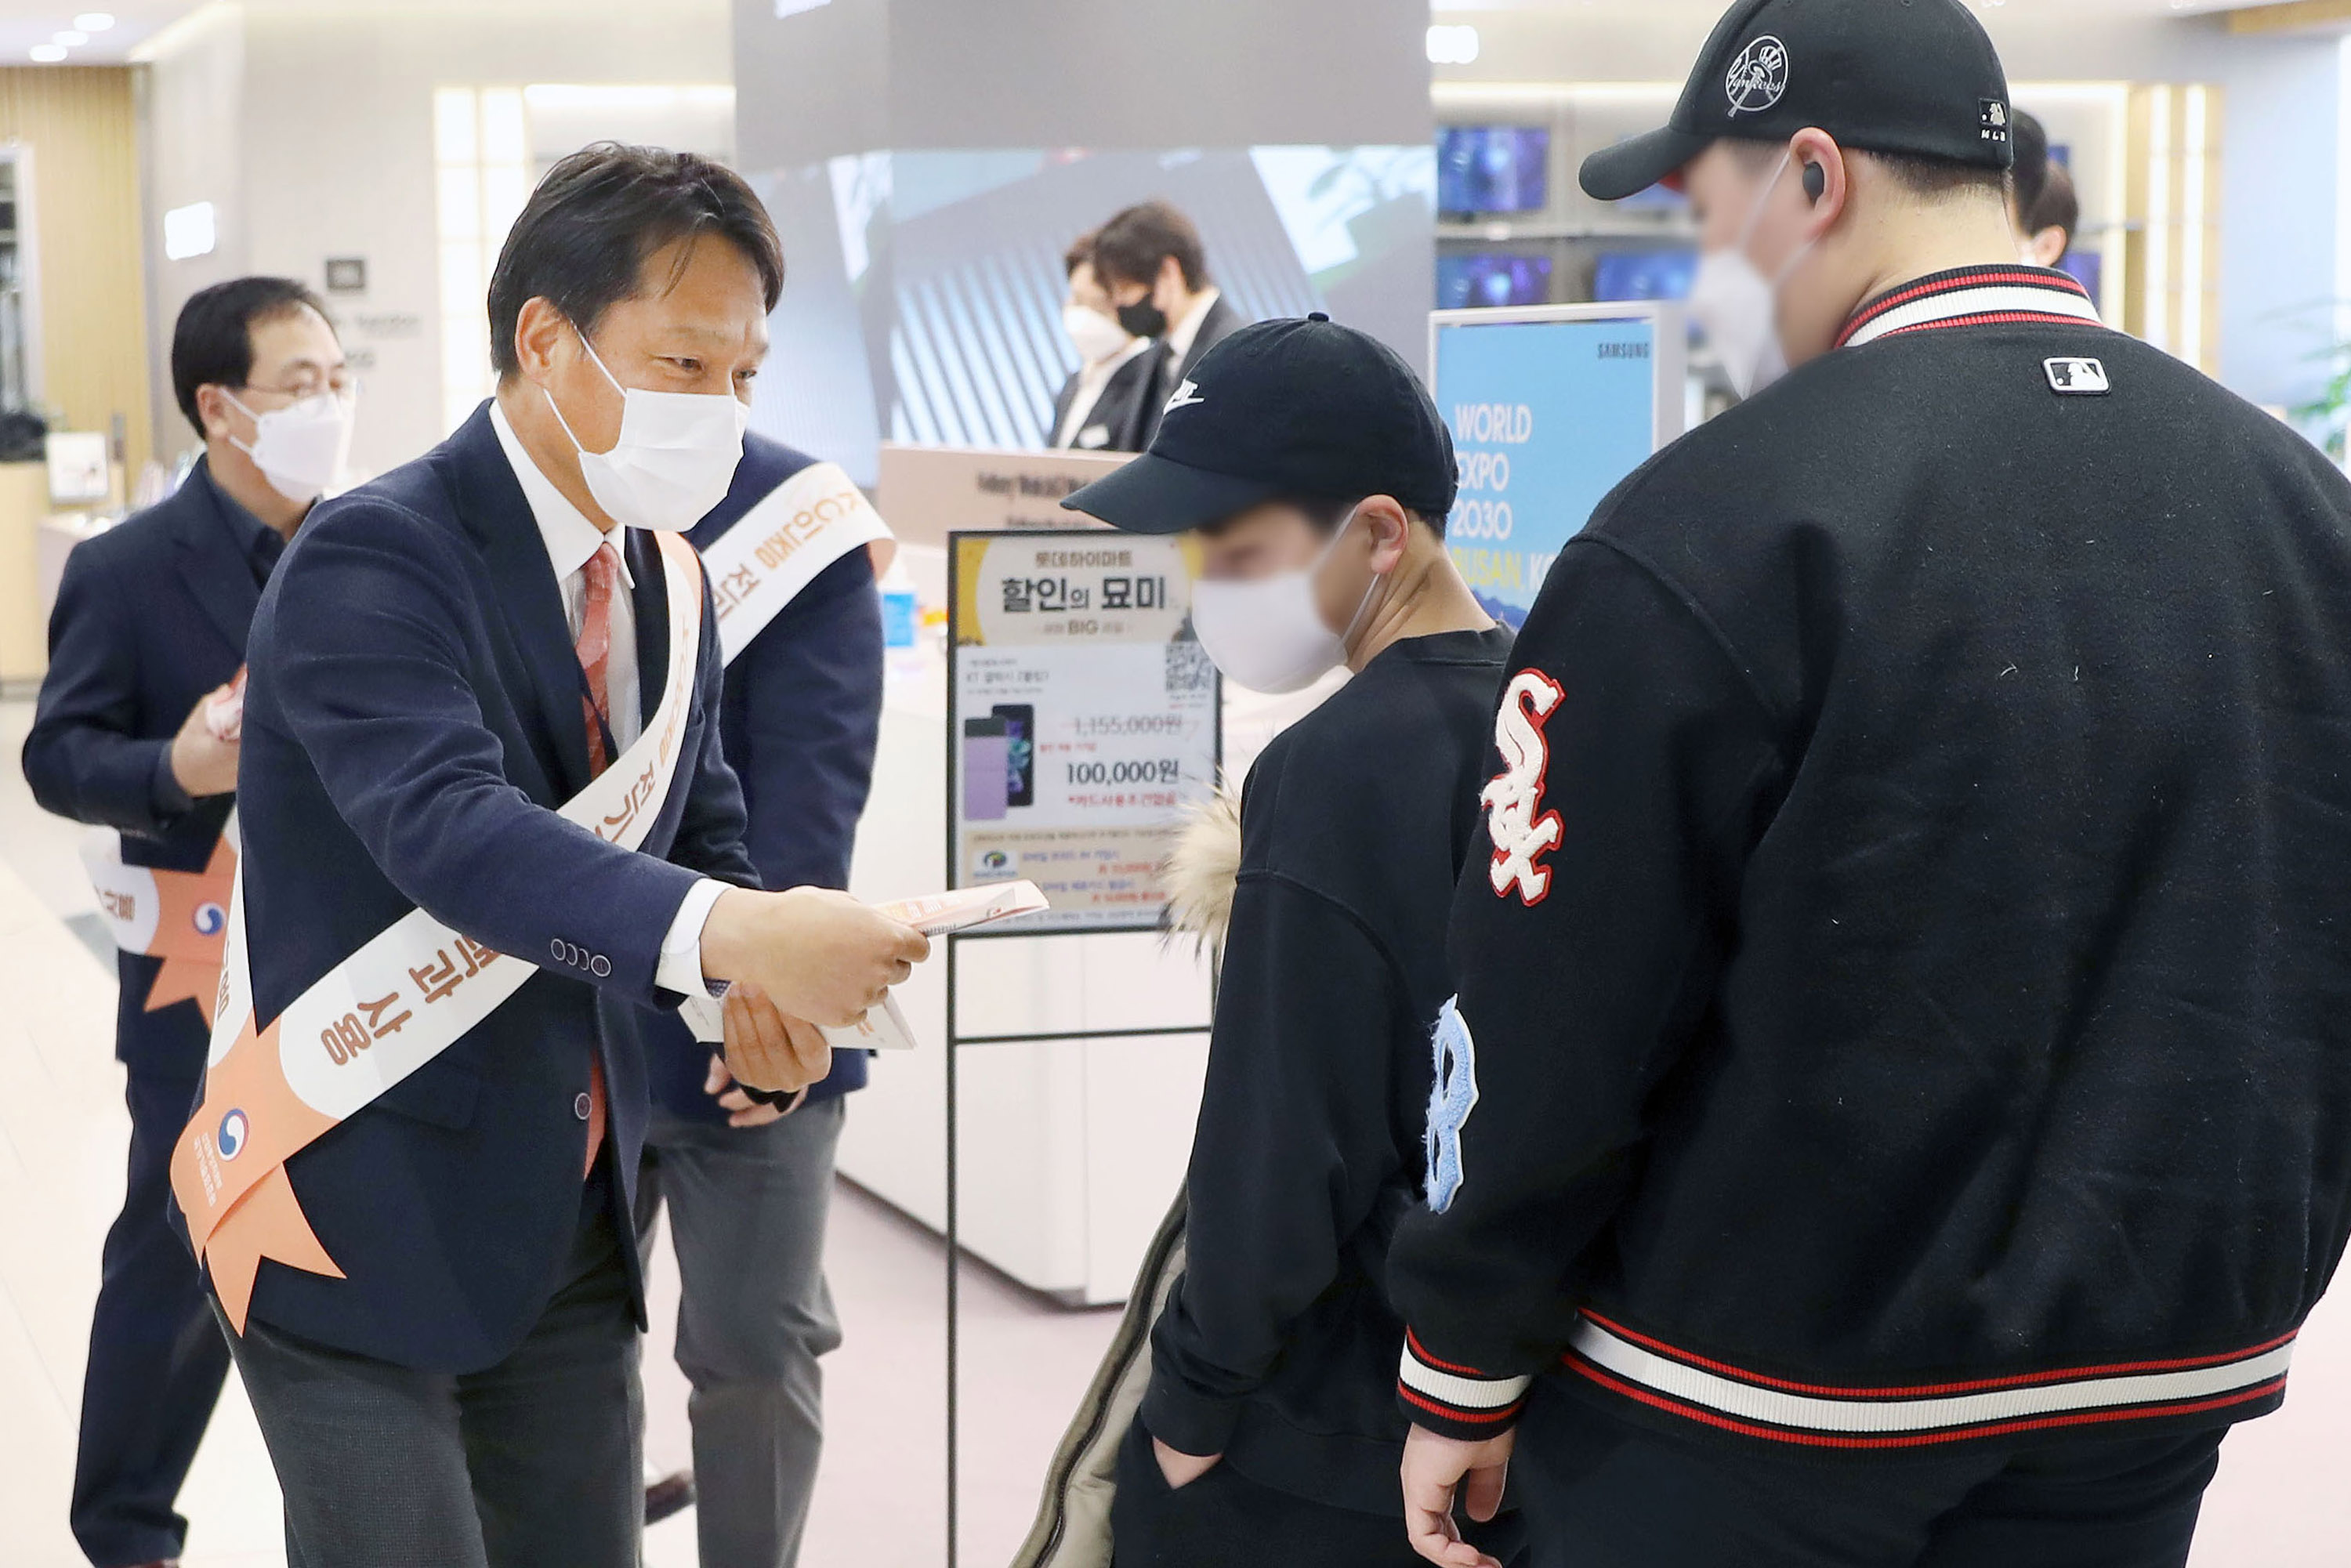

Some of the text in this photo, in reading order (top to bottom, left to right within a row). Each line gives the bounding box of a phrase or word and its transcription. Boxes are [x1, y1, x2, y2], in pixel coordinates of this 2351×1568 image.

[1980, 128, 2007, 142] MLB
[1598, 342, 1650, 360] SAMSUNG
[1454, 403, 1532, 444] WORLD
[1457, 451, 1509, 492] EXPO
[1450, 499, 1512, 541] 2030
[1035, 550, 1132, 569] 롯데하이마트
[1002, 576, 1166, 614] 할인의 묘미
[1074, 714, 1183, 737] 1,155,000원
[1067, 759, 1179, 786] 100,000원
[595, 759, 657, 844] 전기
[321, 991, 412, 1066] 사용
